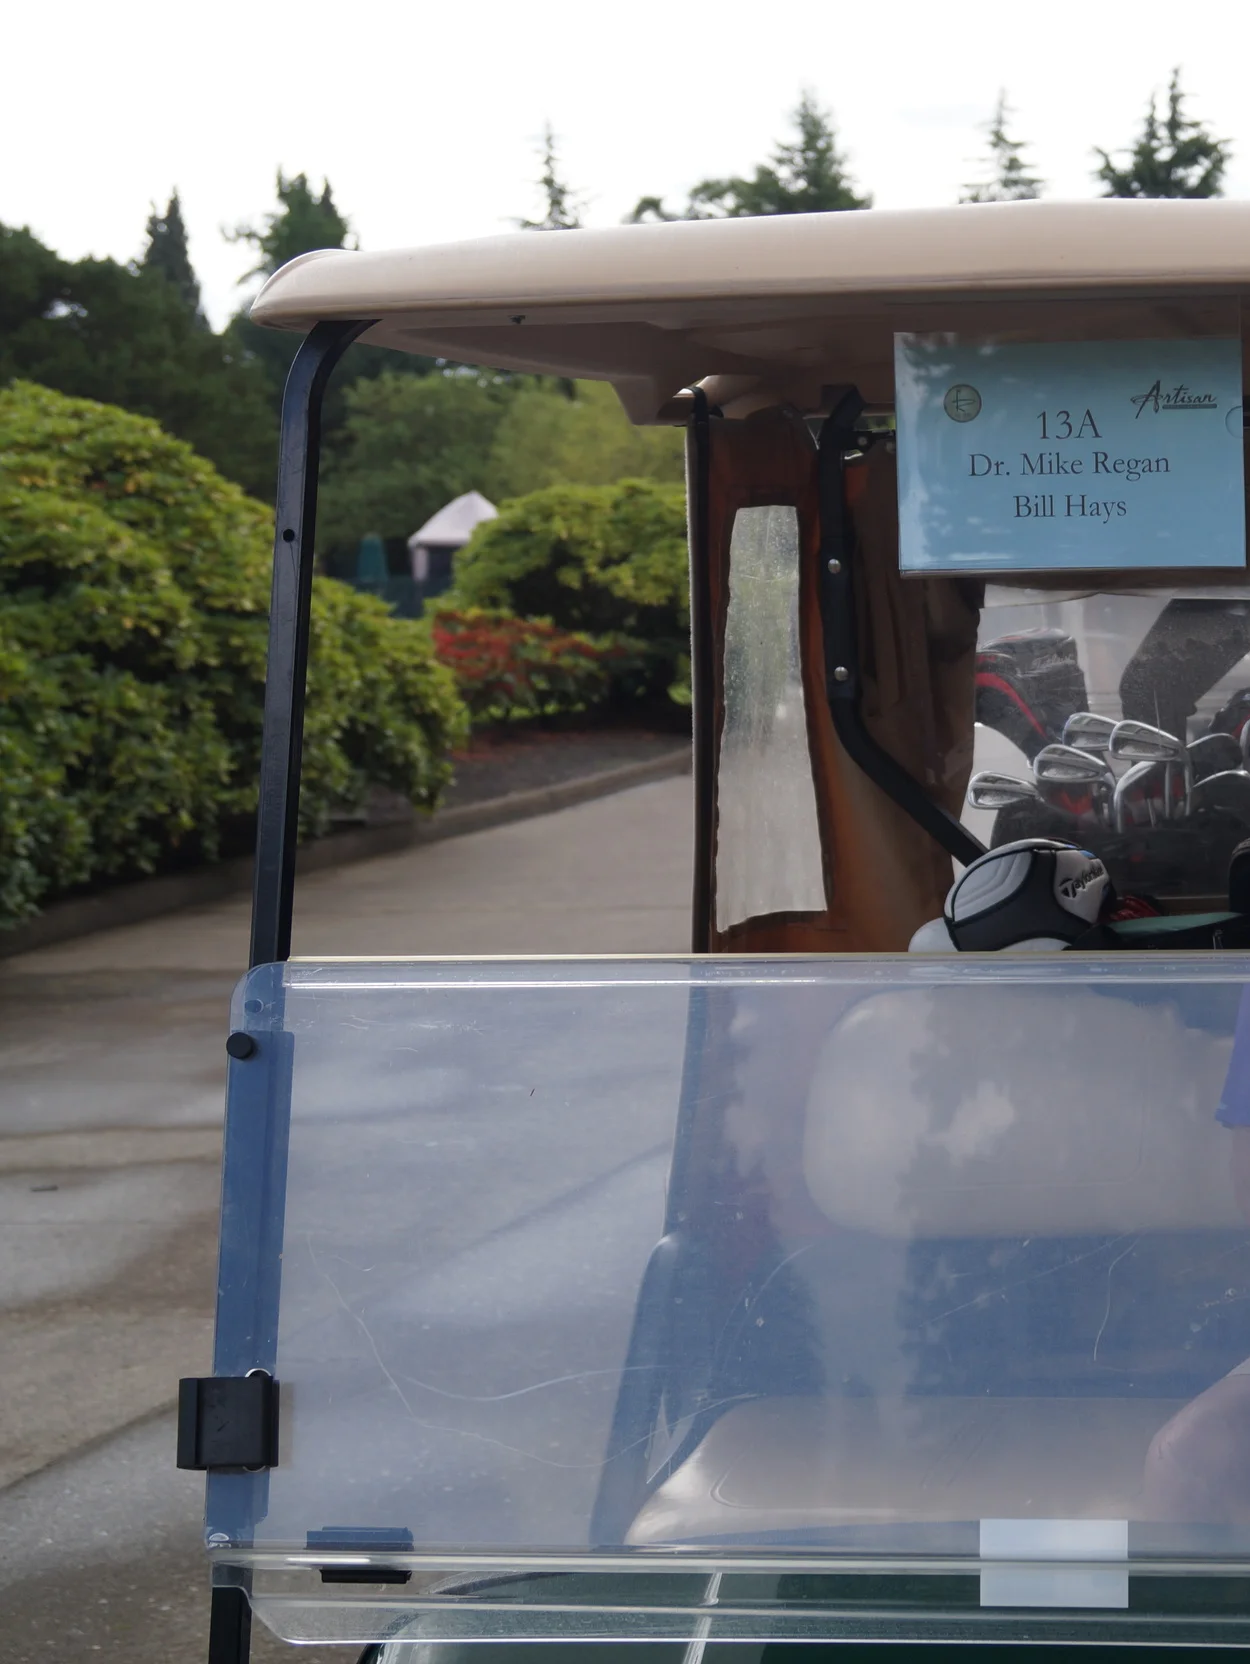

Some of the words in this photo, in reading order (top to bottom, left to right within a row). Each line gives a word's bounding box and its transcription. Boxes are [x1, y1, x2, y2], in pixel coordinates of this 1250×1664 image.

[1130, 380, 1216, 419] Artisan
[1036, 409, 1102, 440] 13A
[969, 453, 1010, 477] Dr.
[1020, 452, 1083, 476] Mike
[1092, 451, 1171, 482] Regan
[1013, 495, 1056, 518] Bill
[1064, 495, 1127, 524] Hays
